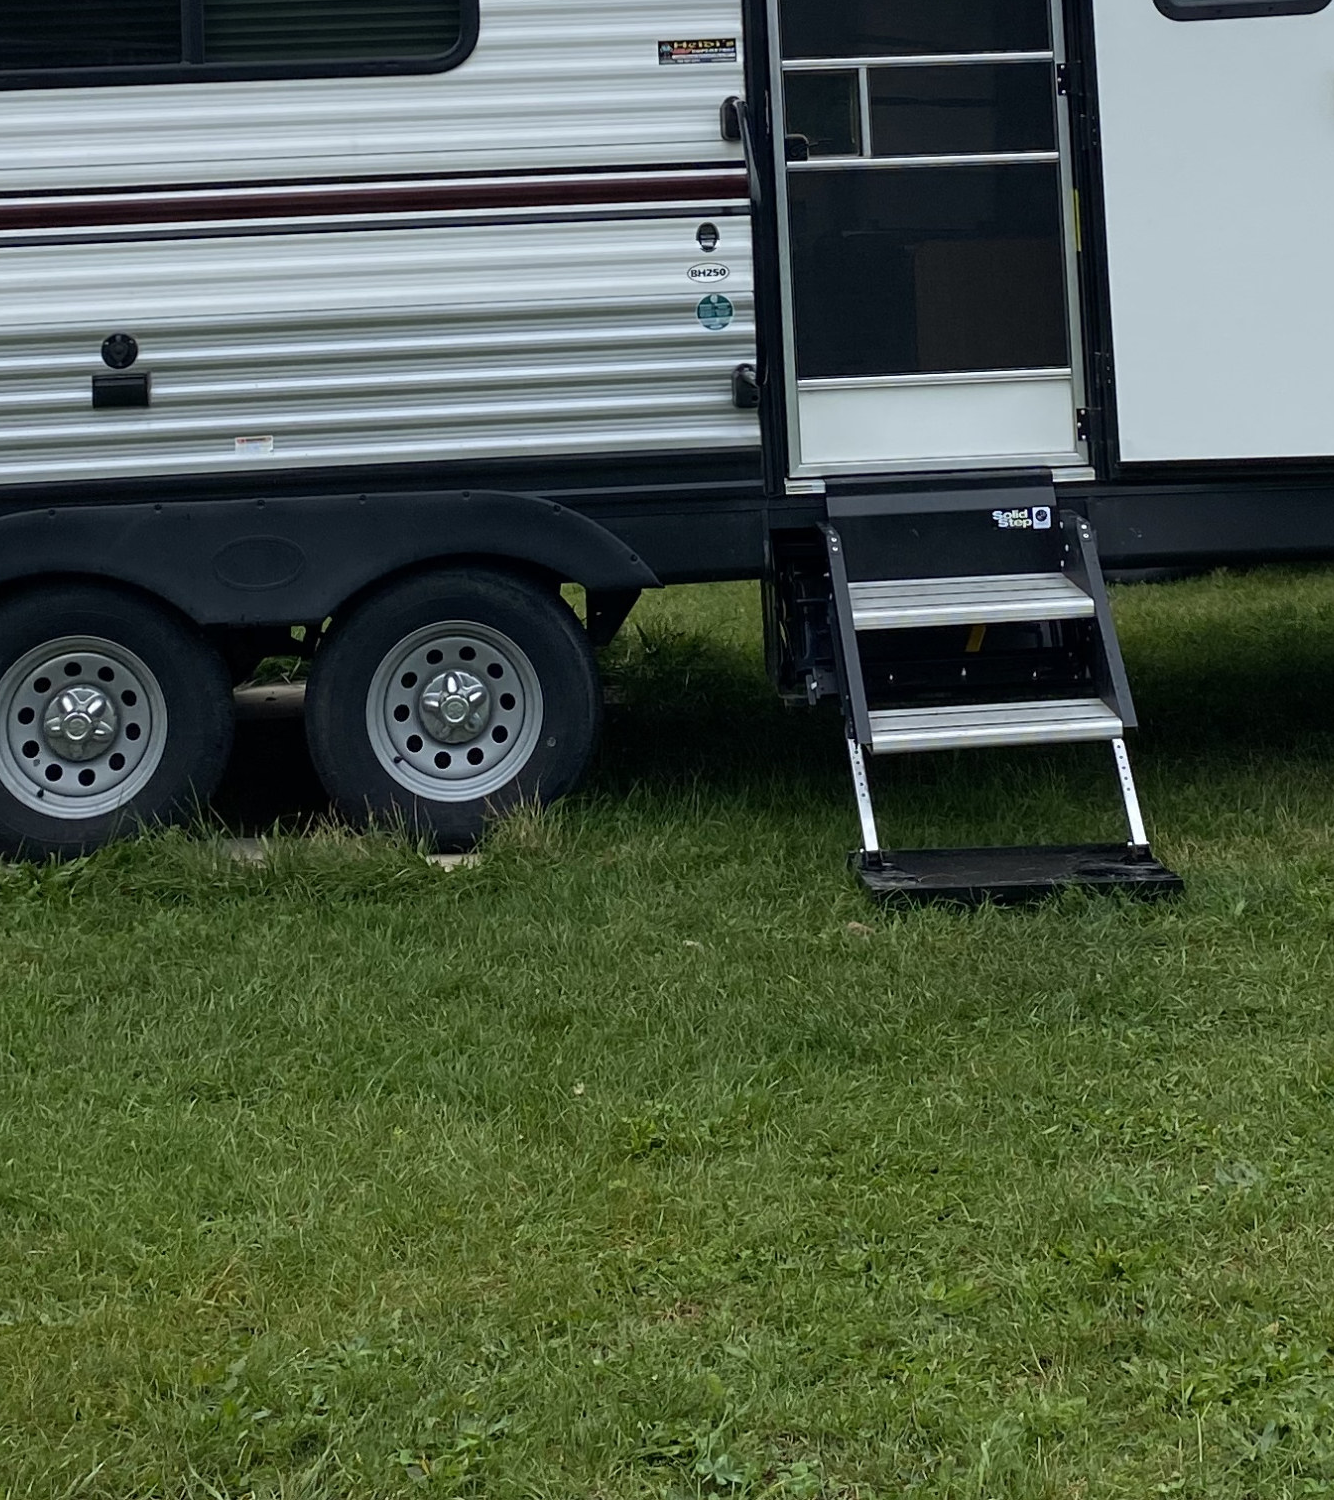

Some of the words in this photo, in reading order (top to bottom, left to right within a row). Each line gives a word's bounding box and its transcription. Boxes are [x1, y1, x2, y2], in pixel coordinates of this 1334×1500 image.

[690, 268, 727, 278] BH250
[992, 509, 1028, 520] Solid
[998, 518, 1033, 529] Step
